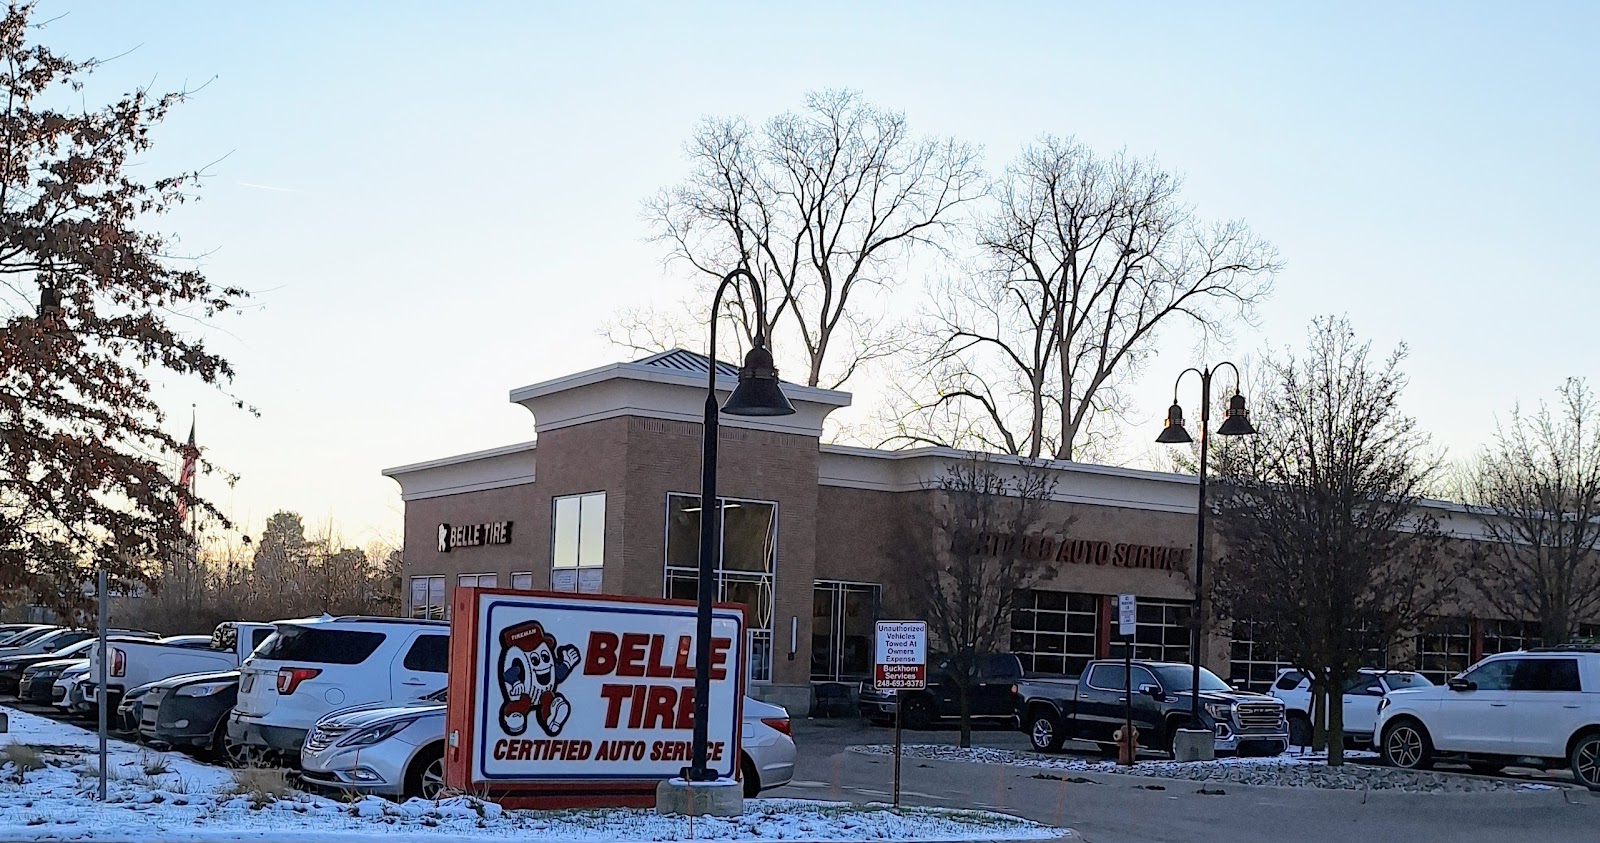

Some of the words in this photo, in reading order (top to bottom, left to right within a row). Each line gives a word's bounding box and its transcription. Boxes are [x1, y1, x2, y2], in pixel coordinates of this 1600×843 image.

[450, 525, 481, 547] BELLE
[484, 521, 510, 544] TIRE
[1056, 539, 1110, 565] AUTO
[583, 630, 732, 680] BELLE
[884, 672, 917, 680] Services
[493, 739, 593, 761] CERTIFIED
[595, 740, 646, 761] AUTO
[650, 740, 725, 761] SERVCE
